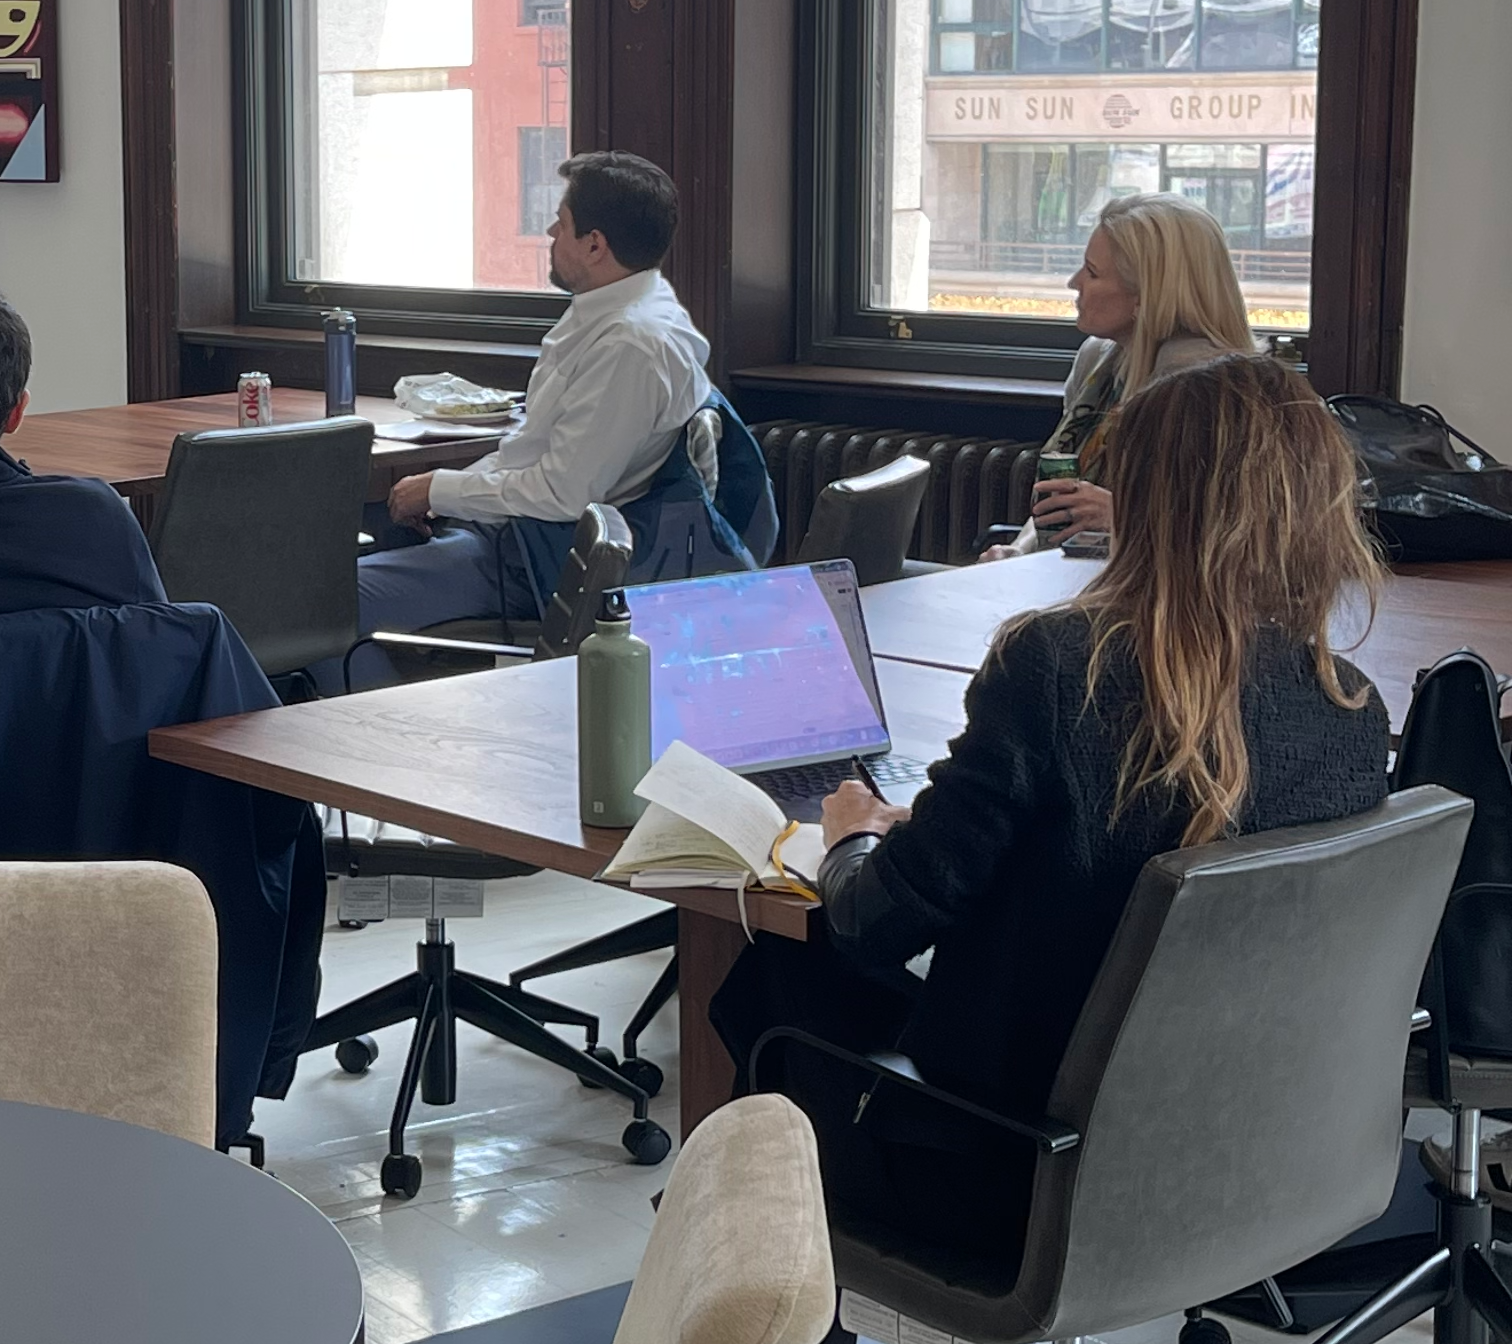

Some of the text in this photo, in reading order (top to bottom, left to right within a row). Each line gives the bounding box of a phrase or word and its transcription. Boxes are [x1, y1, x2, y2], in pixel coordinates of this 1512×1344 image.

[954, 96, 1001, 120] SUN
[1025, 96, 1074, 120] SUN
[1170, 94, 1262, 120] GROUP
